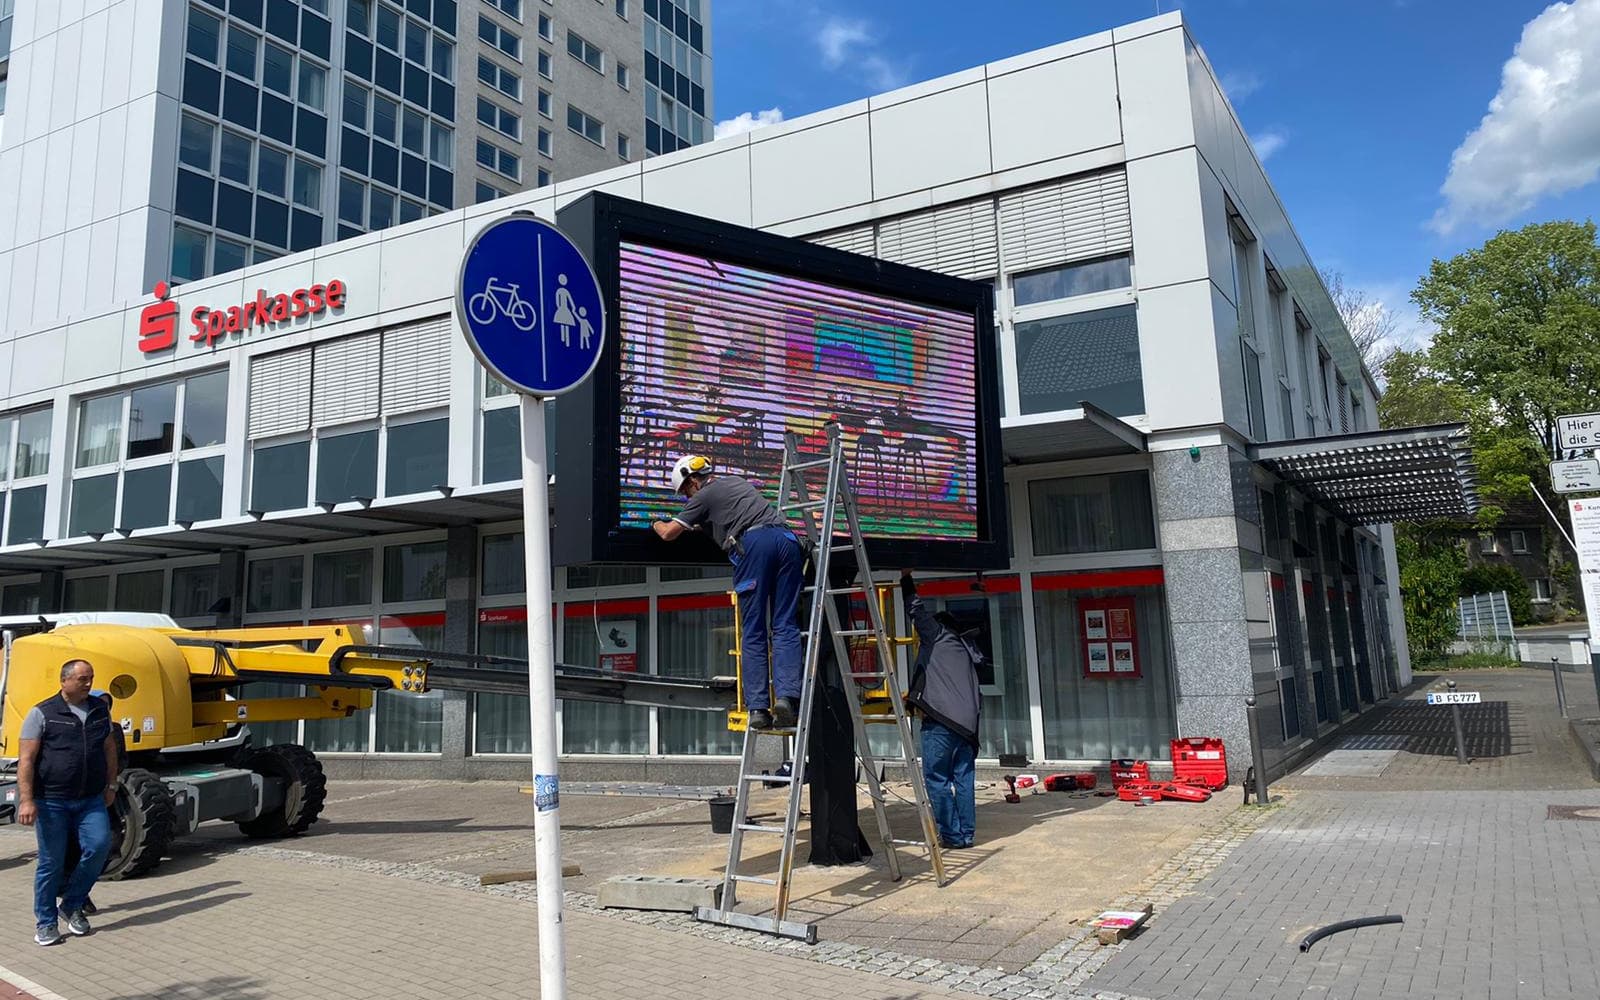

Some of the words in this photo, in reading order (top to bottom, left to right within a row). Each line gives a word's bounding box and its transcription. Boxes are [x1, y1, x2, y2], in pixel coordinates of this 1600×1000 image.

[189, 279, 345, 346] Sparkasse
[1567, 420, 1594, 430] Hier
[1569, 434, 1587, 444] die
[1435, 694, 1442, 703] B
